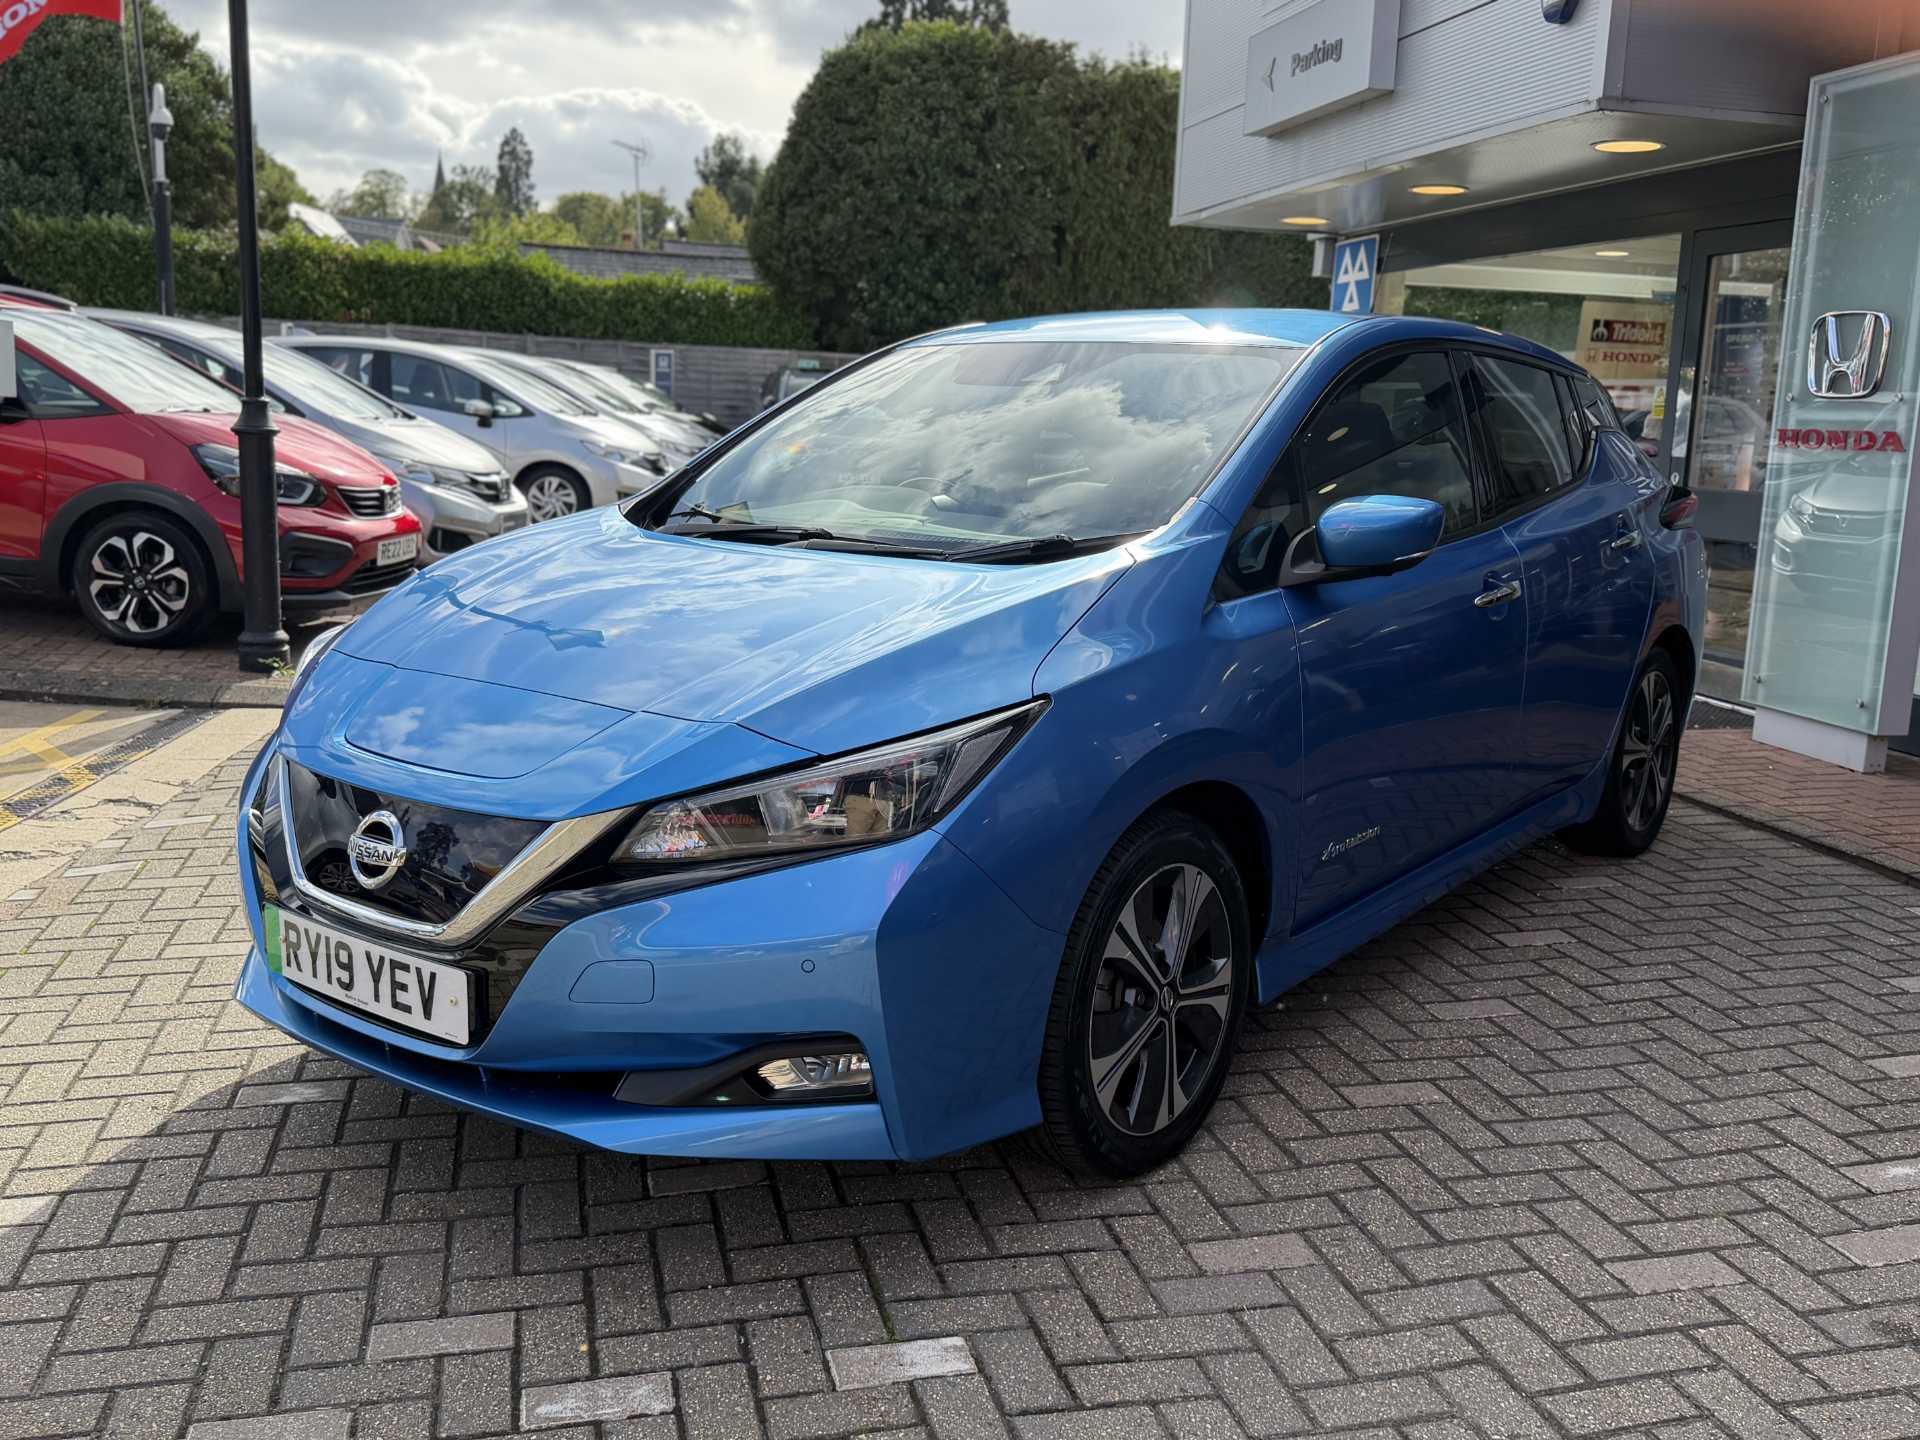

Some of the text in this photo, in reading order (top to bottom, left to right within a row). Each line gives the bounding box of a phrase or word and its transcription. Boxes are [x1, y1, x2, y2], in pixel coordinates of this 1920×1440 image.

[1291, 37, 1343, 78] Parking
[1611, 321, 1664, 344] Trident
[1776, 427, 1906, 453] HONDA
[350, 838, 394, 862] NISSAN
[284, 919, 437, 1021] RY19 YEV
